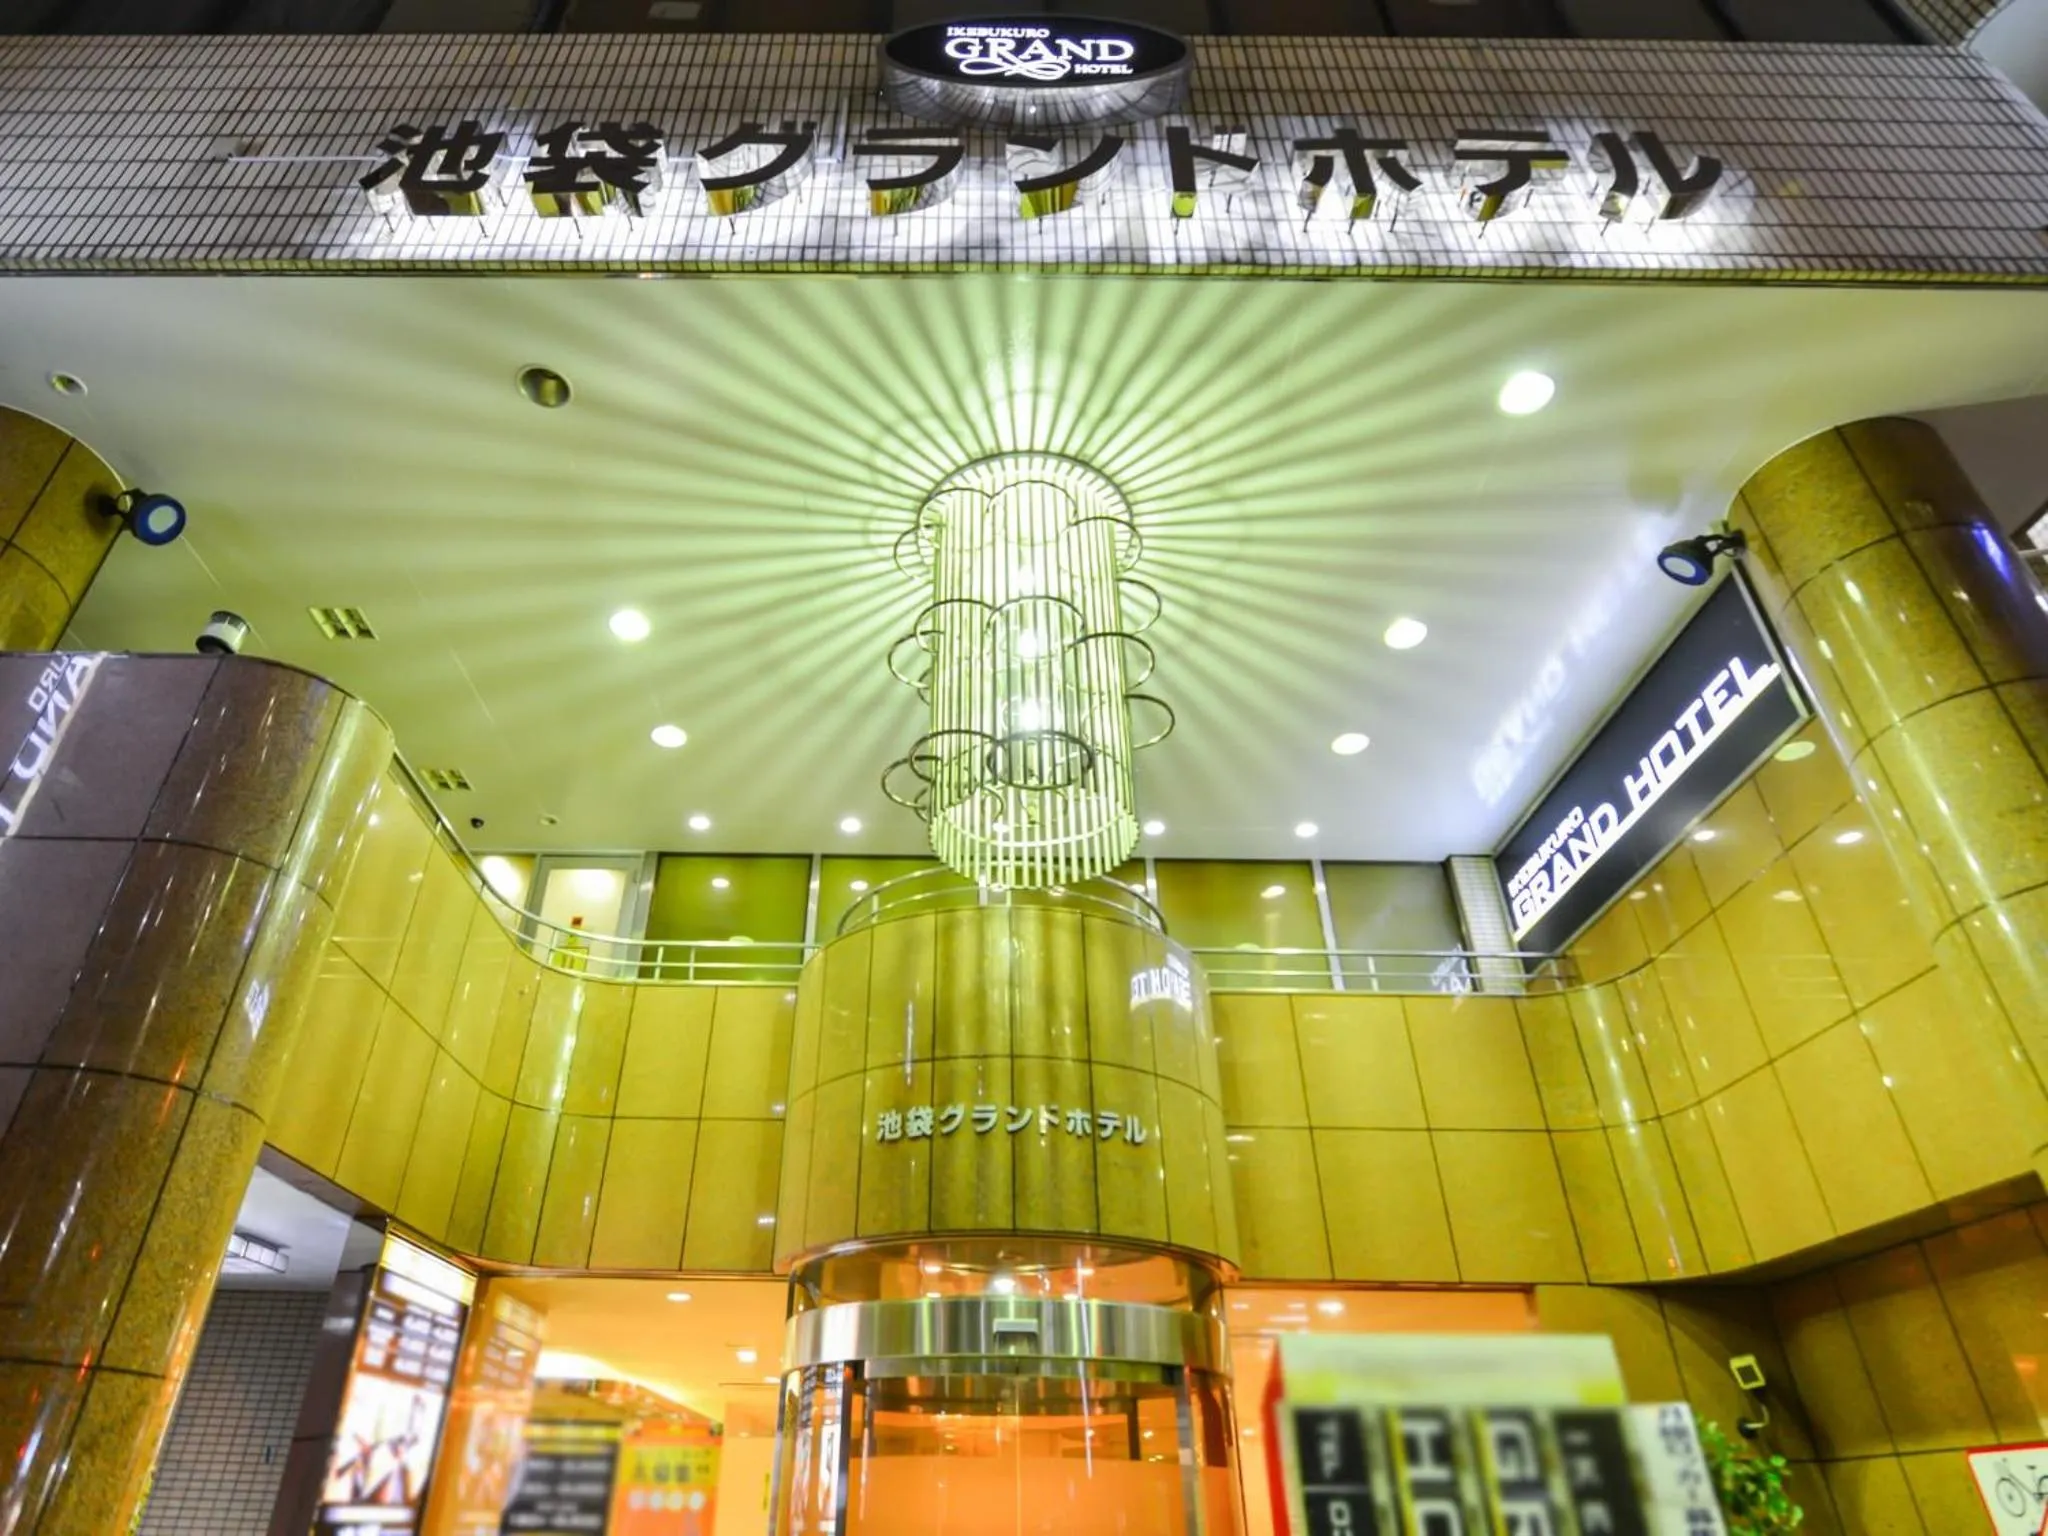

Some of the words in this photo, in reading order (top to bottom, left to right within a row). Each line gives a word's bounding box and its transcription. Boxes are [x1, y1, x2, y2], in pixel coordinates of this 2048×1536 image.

[947, 26, 1050, 38] IKEBUKURO
[945, 37, 1134, 66] GRAND
[1074, 63, 1134, 74] HOTEL
[359, 119, 1723, 206] 池袋グランドホテル
[1510, 802, 1620, 931] GRAND
[1623, 656, 1781, 811] HOTEL
[876, 1104, 1149, 1145] 池袋グランドホテル
